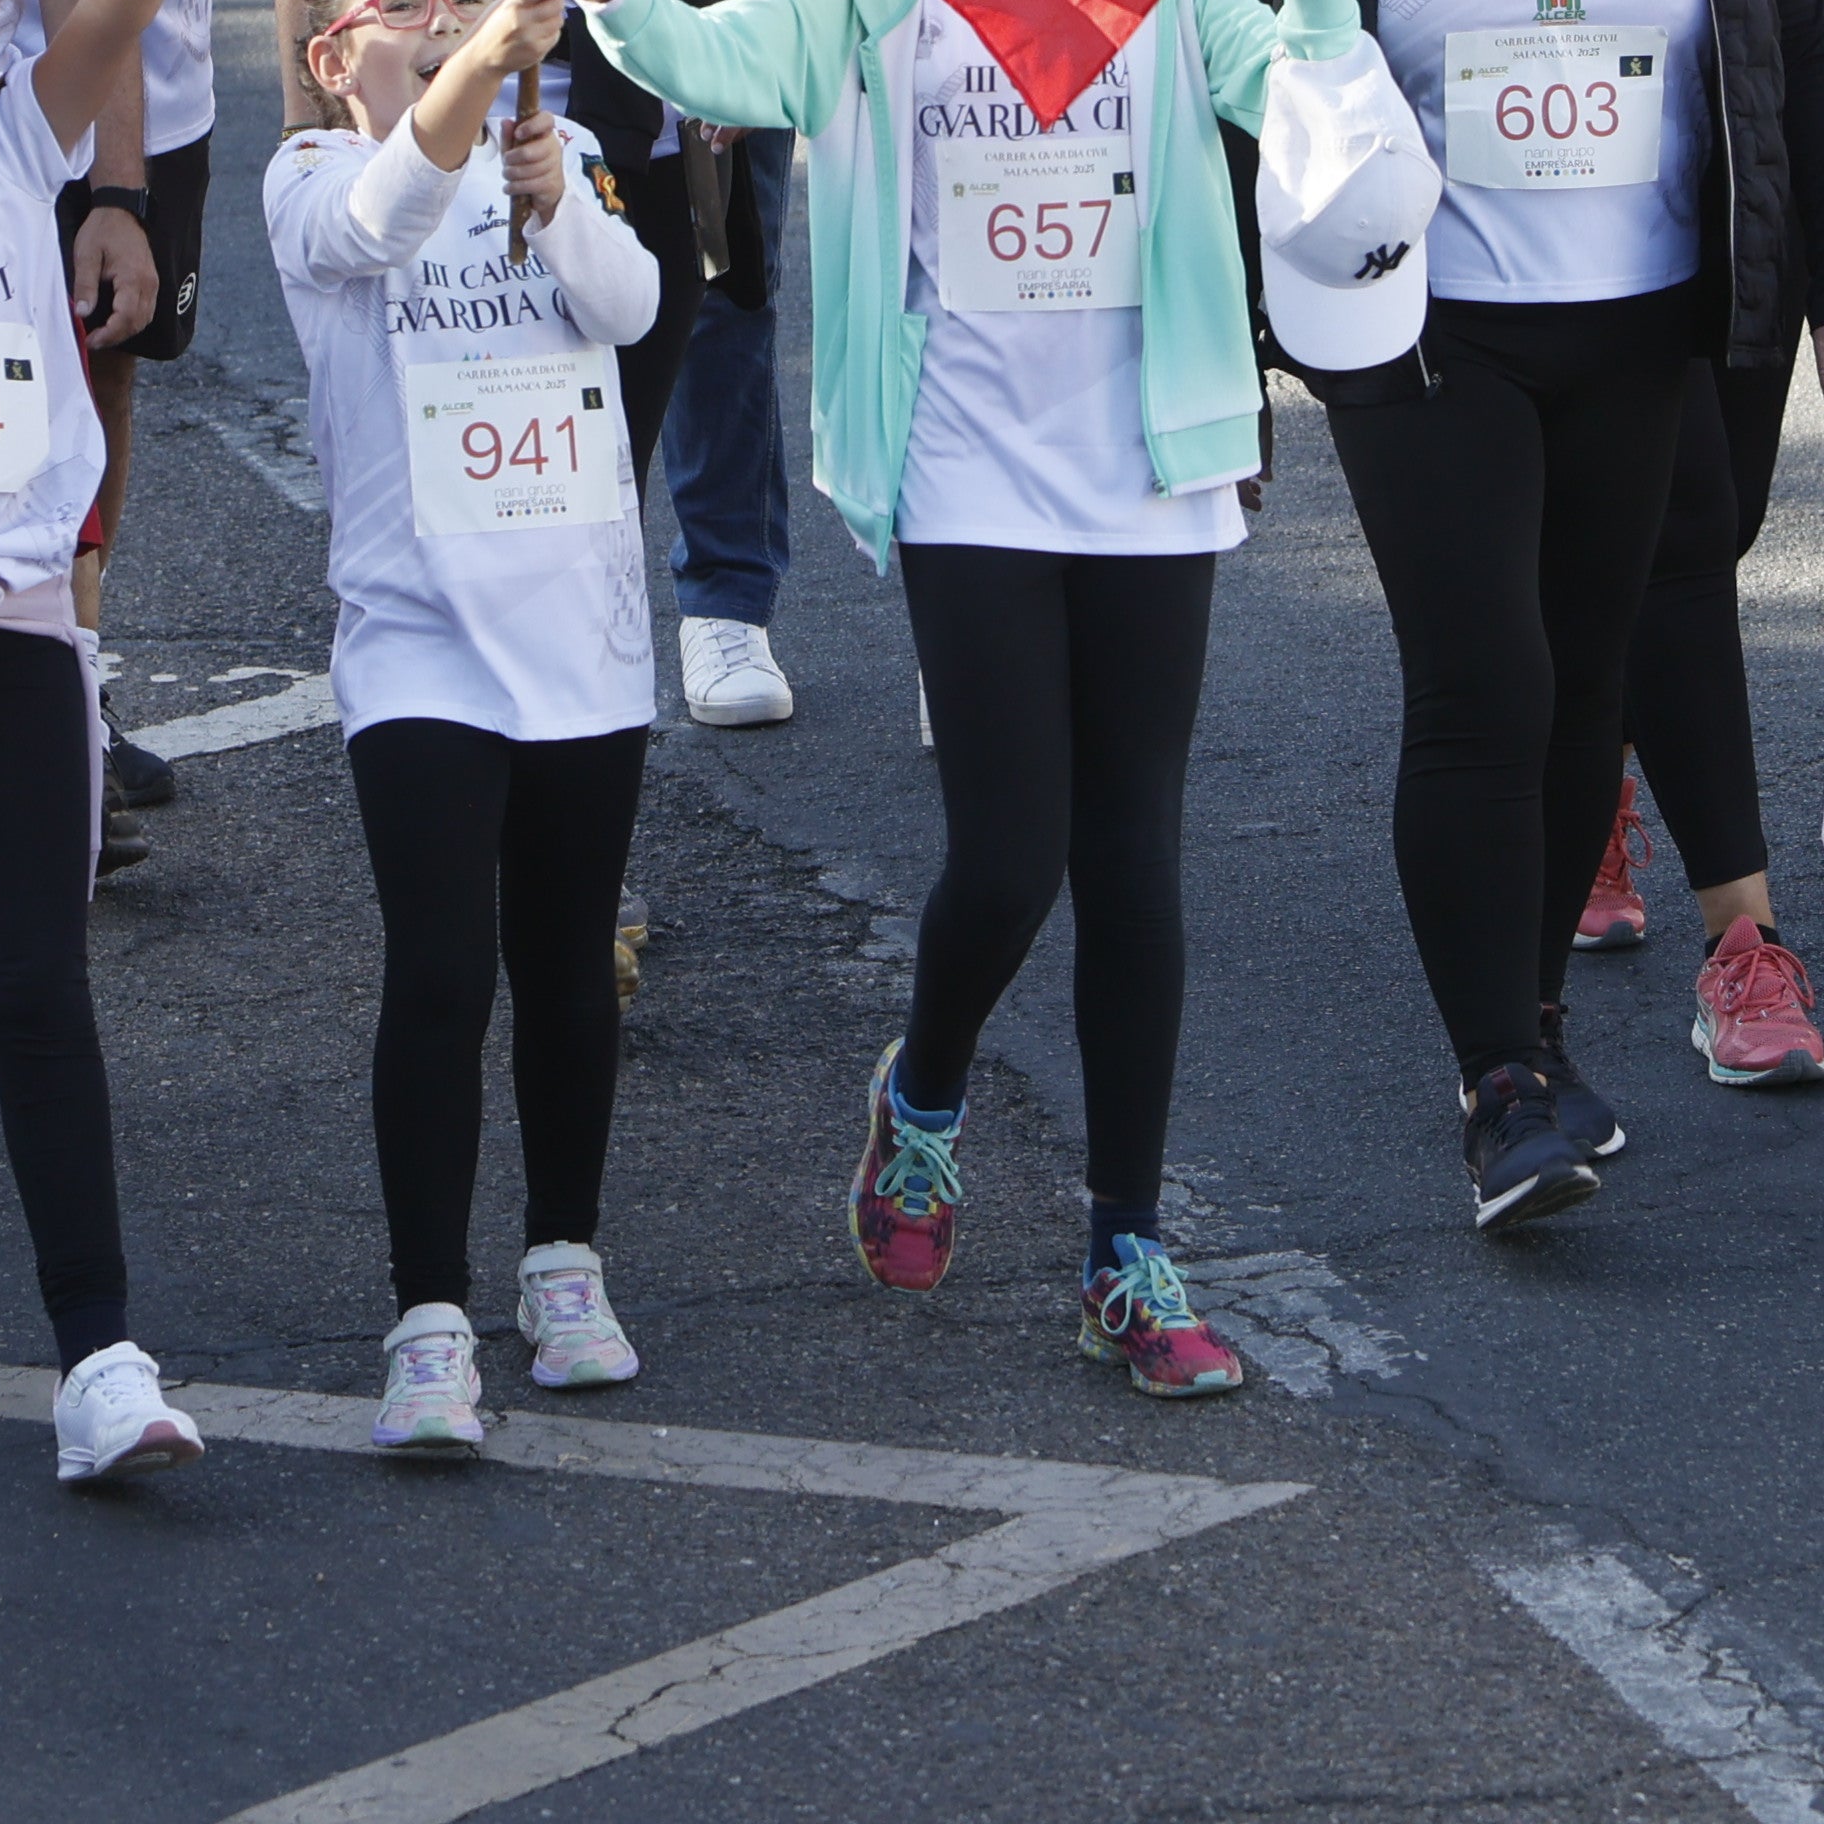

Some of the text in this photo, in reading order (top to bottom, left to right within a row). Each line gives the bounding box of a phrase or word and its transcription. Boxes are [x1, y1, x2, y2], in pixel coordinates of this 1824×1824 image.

[1532, 10, 1587, 20] ALCER
[1495, 36, 1543, 47] CARRERA
[1513, 47, 1600, 59] SALAMANCA 2025
[965, 66, 997, 93] III
[1496, 81, 1619, 141] 603
[1525, 146, 1595, 162] nani grupo
[1073, 163, 1095, 175] 2025
[1525, 160, 1595, 169] EMPRESARIAL
[987, 199, 1112, 262] 657
[422, 260, 448, 286] III
[1051, 266, 1092, 284] grupo
[1018, 279, 1091, 291] EMPRESARIAL
[545, 380, 566, 391] 2025
[461, 415, 579, 480] 941
[495, 484, 566, 501] nani grupo
[495, 497, 566, 510] EMPRESARIAL
